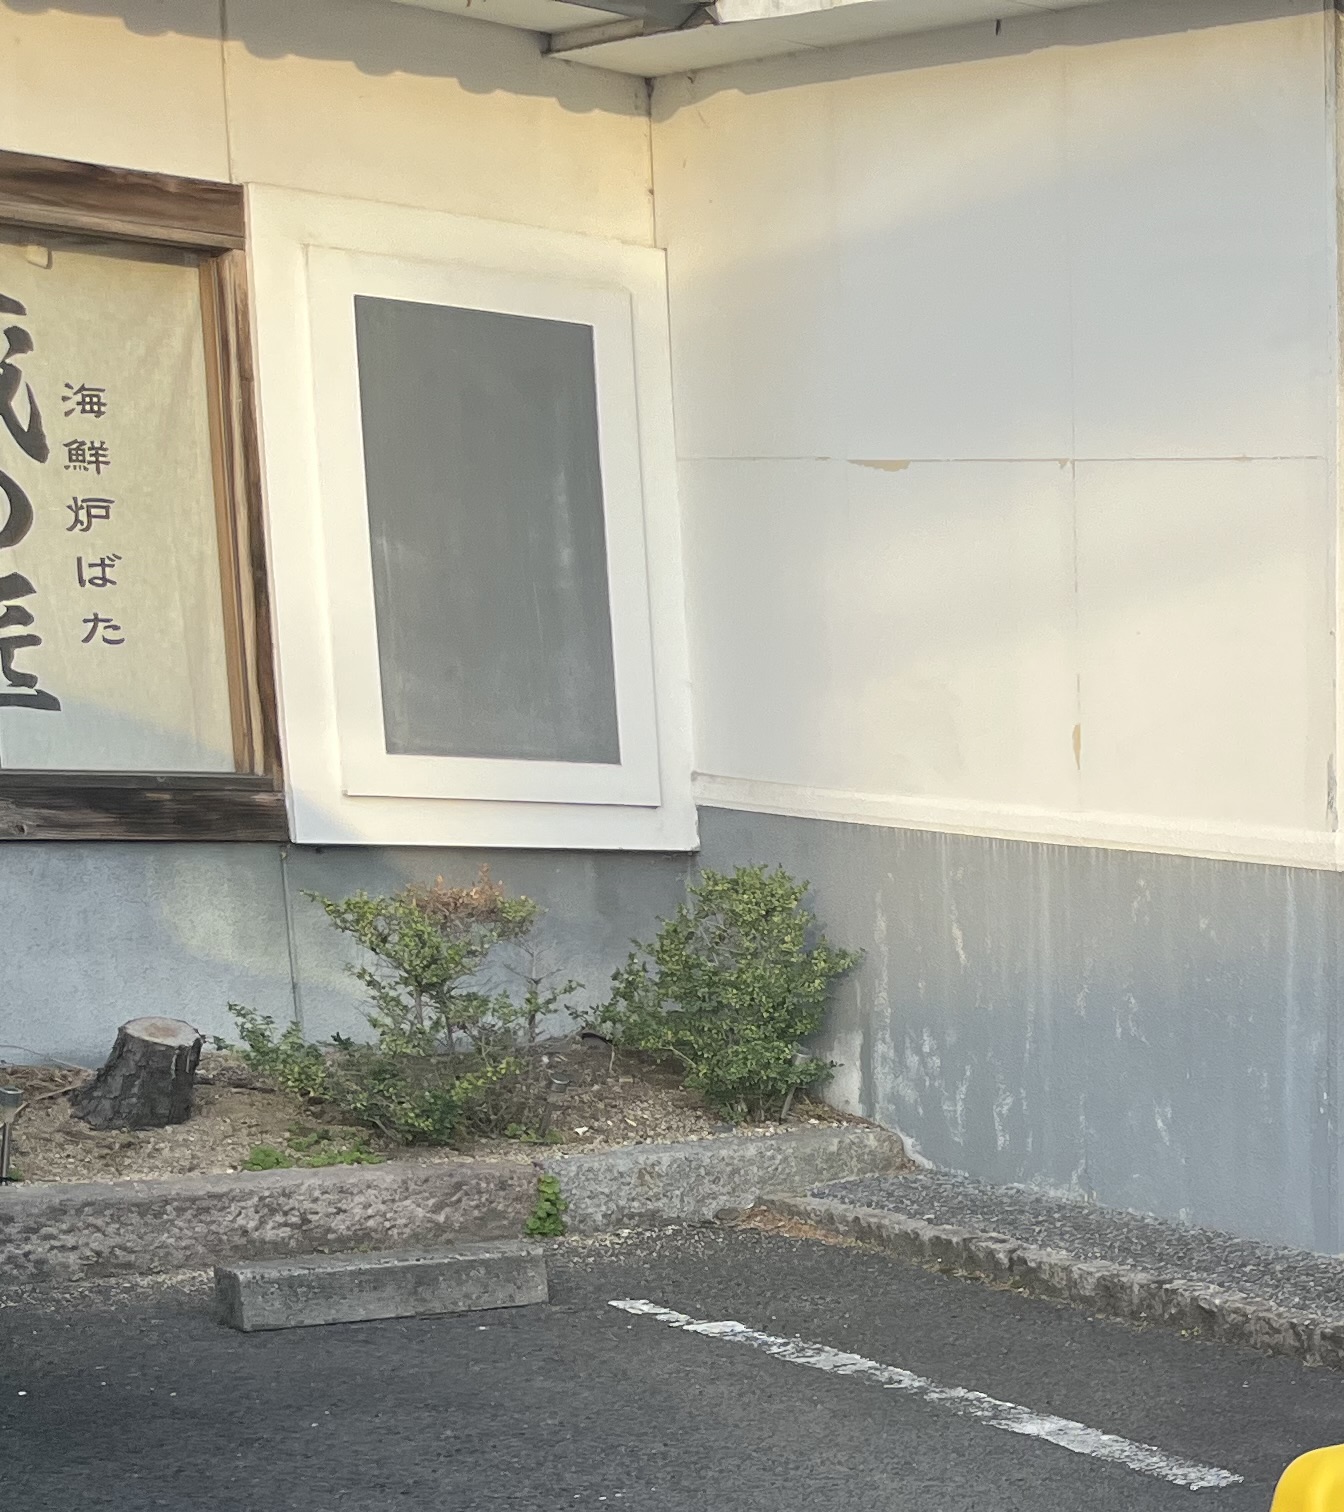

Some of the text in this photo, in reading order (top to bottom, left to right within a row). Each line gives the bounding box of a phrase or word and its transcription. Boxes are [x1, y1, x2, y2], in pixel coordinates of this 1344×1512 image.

[61, 381, 126, 646] 海鮮炉ばた
